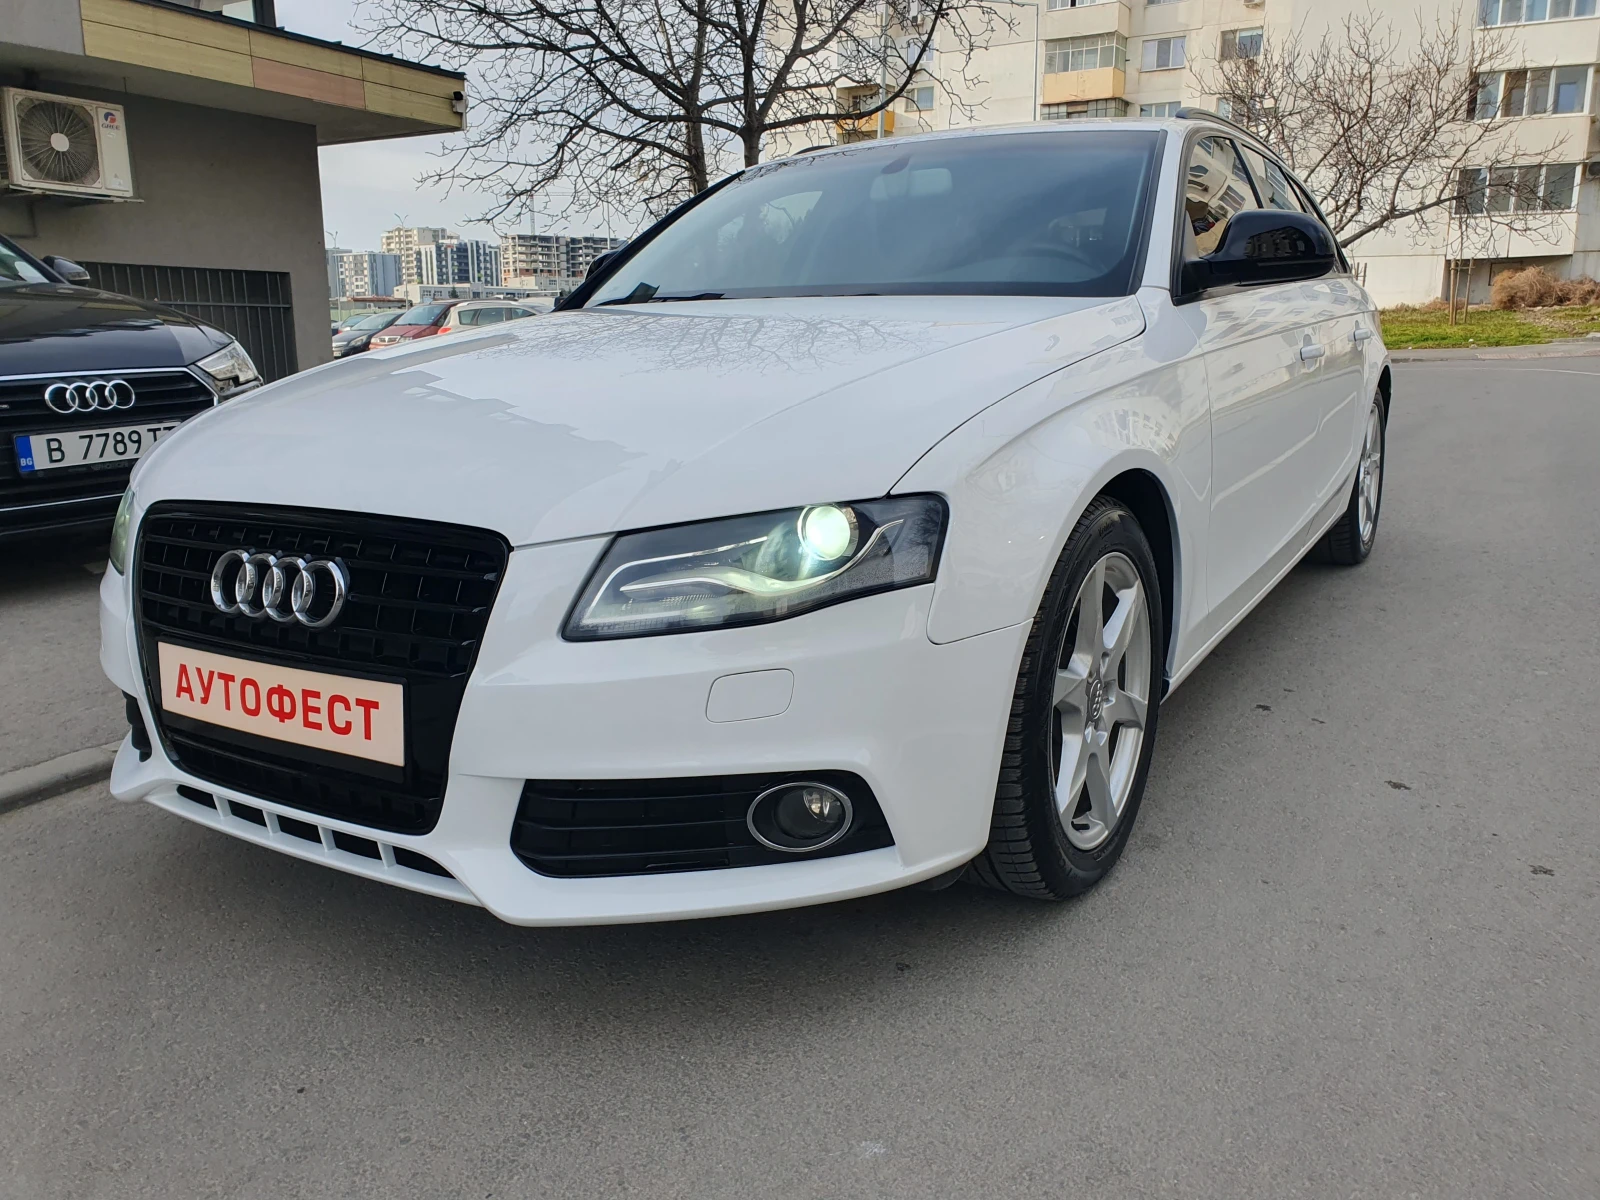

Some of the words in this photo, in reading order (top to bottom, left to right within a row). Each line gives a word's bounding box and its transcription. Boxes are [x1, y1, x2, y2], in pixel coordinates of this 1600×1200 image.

[20, 458, 33, 467] BG
[46, 438, 65, 463] B
[79, 430, 142, 460] 7789
[175, 663, 380, 741] АУТОФЕСТ
